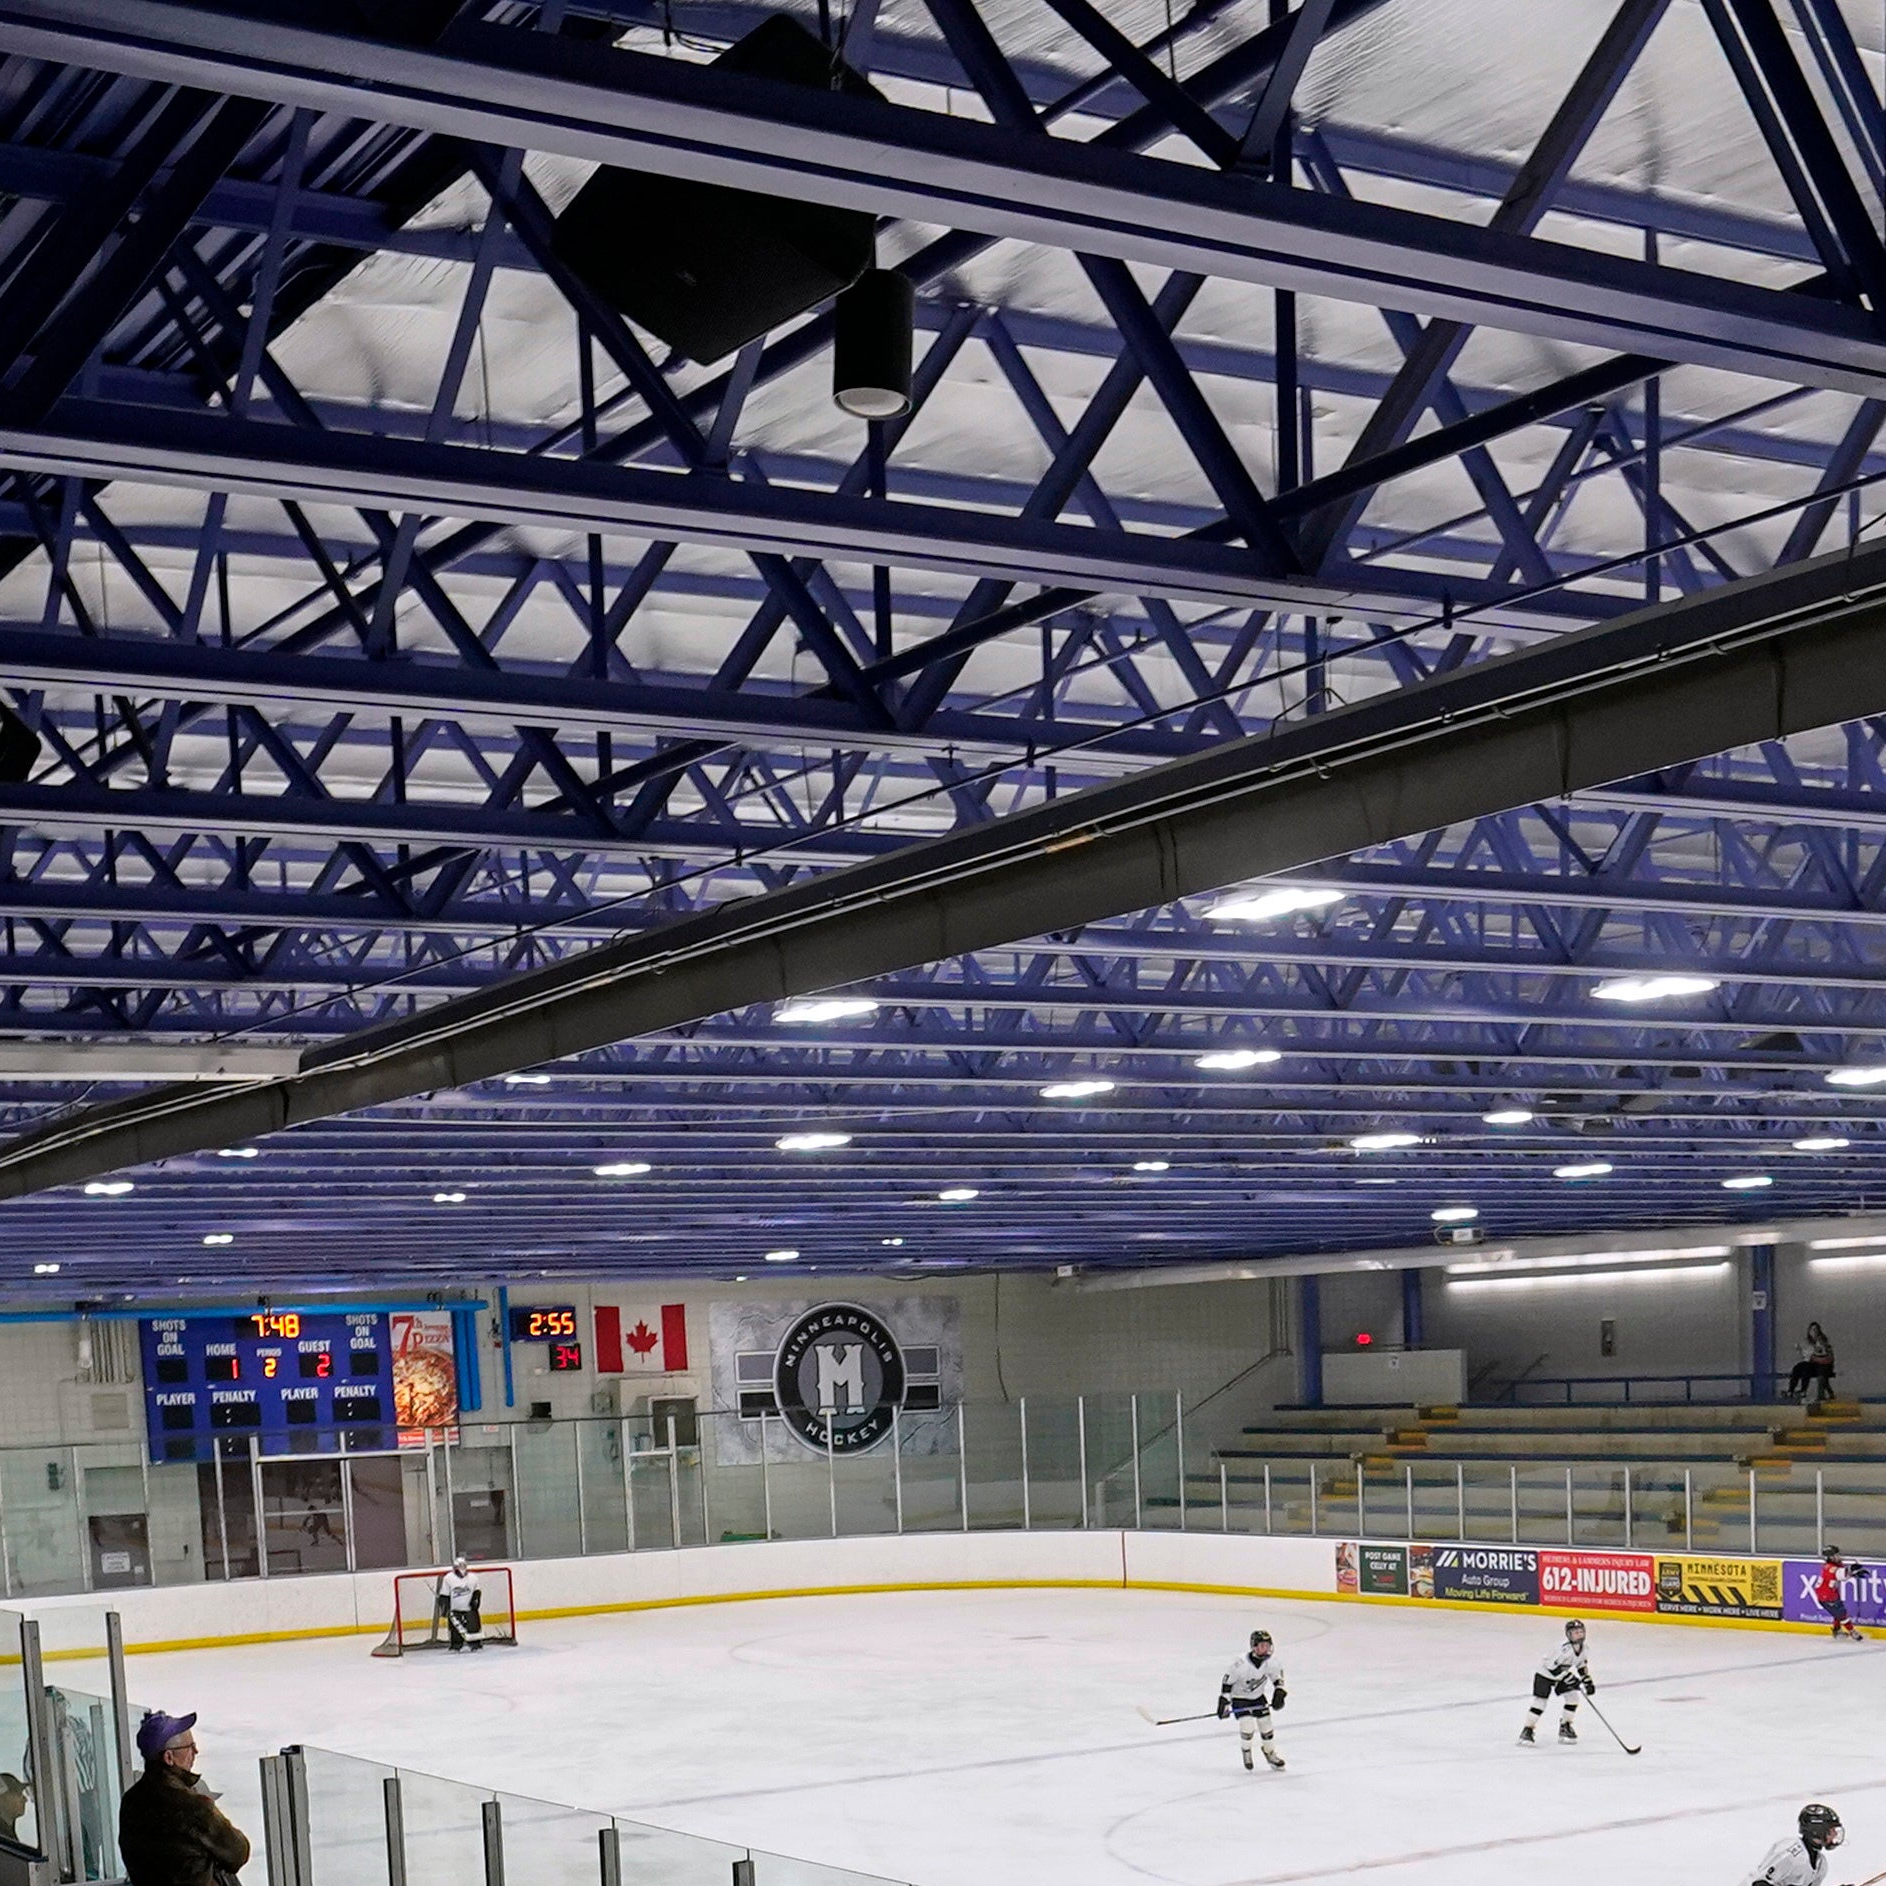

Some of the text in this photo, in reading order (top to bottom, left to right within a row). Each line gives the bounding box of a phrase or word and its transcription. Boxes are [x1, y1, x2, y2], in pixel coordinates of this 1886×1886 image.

[152, 1319, 186, 1332] SHOTS
[251, 1314, 300, 1338] 7:48
[346, 1314, 378, 1326] SHOTS
[530, 1312, 574, 1336] 2:55
[163, 1332, 178, 1343] ON
[355, 1326, 370, 1337] ON
[298, 1340, 331, 1353] GUEST
[350, 1337, 376, 1349] GOAL
[785, 1315, 893, 1367] MINNEAPOLIS
[157, 1344, 185, 1356] GOAL
[206, 1343, 236, 1356] HOME
[556, 1346, 579, 1369] 34
[232, 1359, 239, 1379] 1
[264, 1357, 277, 1378] 2
[317, 1353, 331, 1378] 2
[815, 1343, 866, 1416] M
[156, 1390, 256, 1405] PLAYER PENALTY
[281, 1385, 377, 1400] PLAYER PENALTY
[806, 1419, 878, 1446] HOCKEY
[1463, 1552, 1537, 1572] MORRIE'S
[1687, 1563, 1747, 1576] MINNESOTA
[1461, 1574, 1510, 1588] Auto Group
[1542, 1566, 1651, 1596] 612-INJURED
[1445, 1587, 1474, 1600] Moving
[1475, 1589, 1490, 1599] Life
